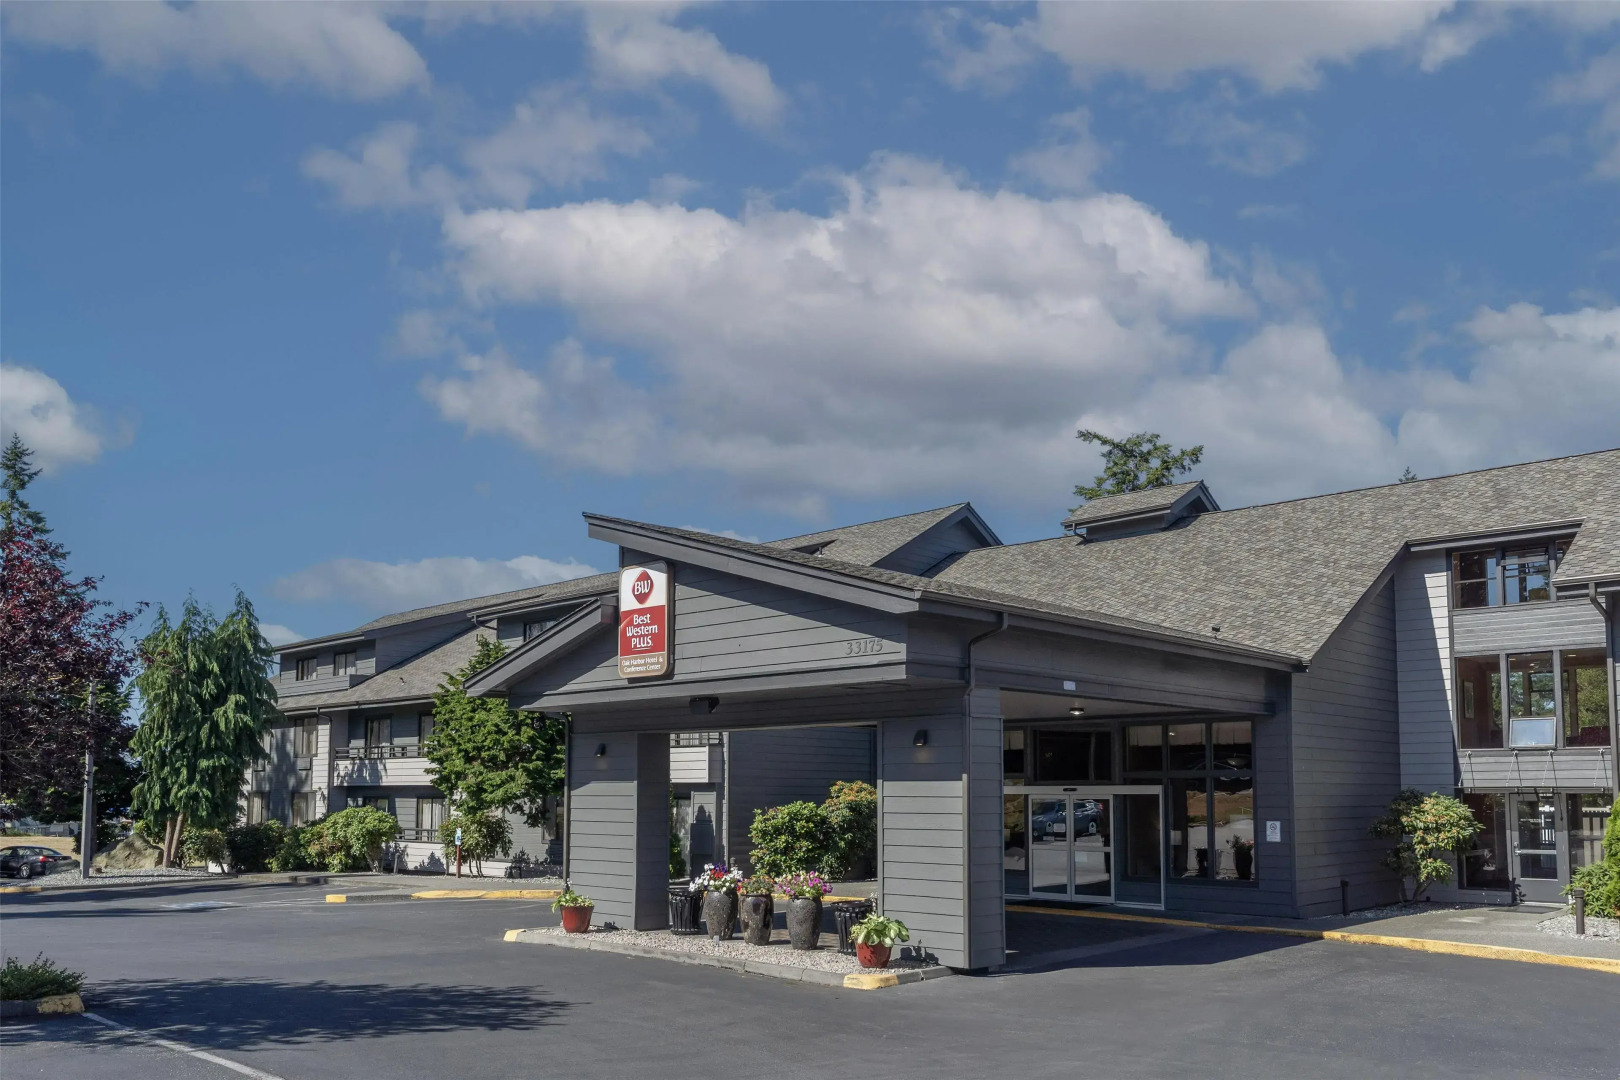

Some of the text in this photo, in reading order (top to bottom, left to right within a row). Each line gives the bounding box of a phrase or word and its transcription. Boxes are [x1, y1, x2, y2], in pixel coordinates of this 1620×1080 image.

[634, 580, 651, 595] BW
[633, 613, 650, 625] Best
[626, 624, 658, 637] Western
[631, 636, 652, 648] PLUS
[846, 638, 883, 655] 33175
